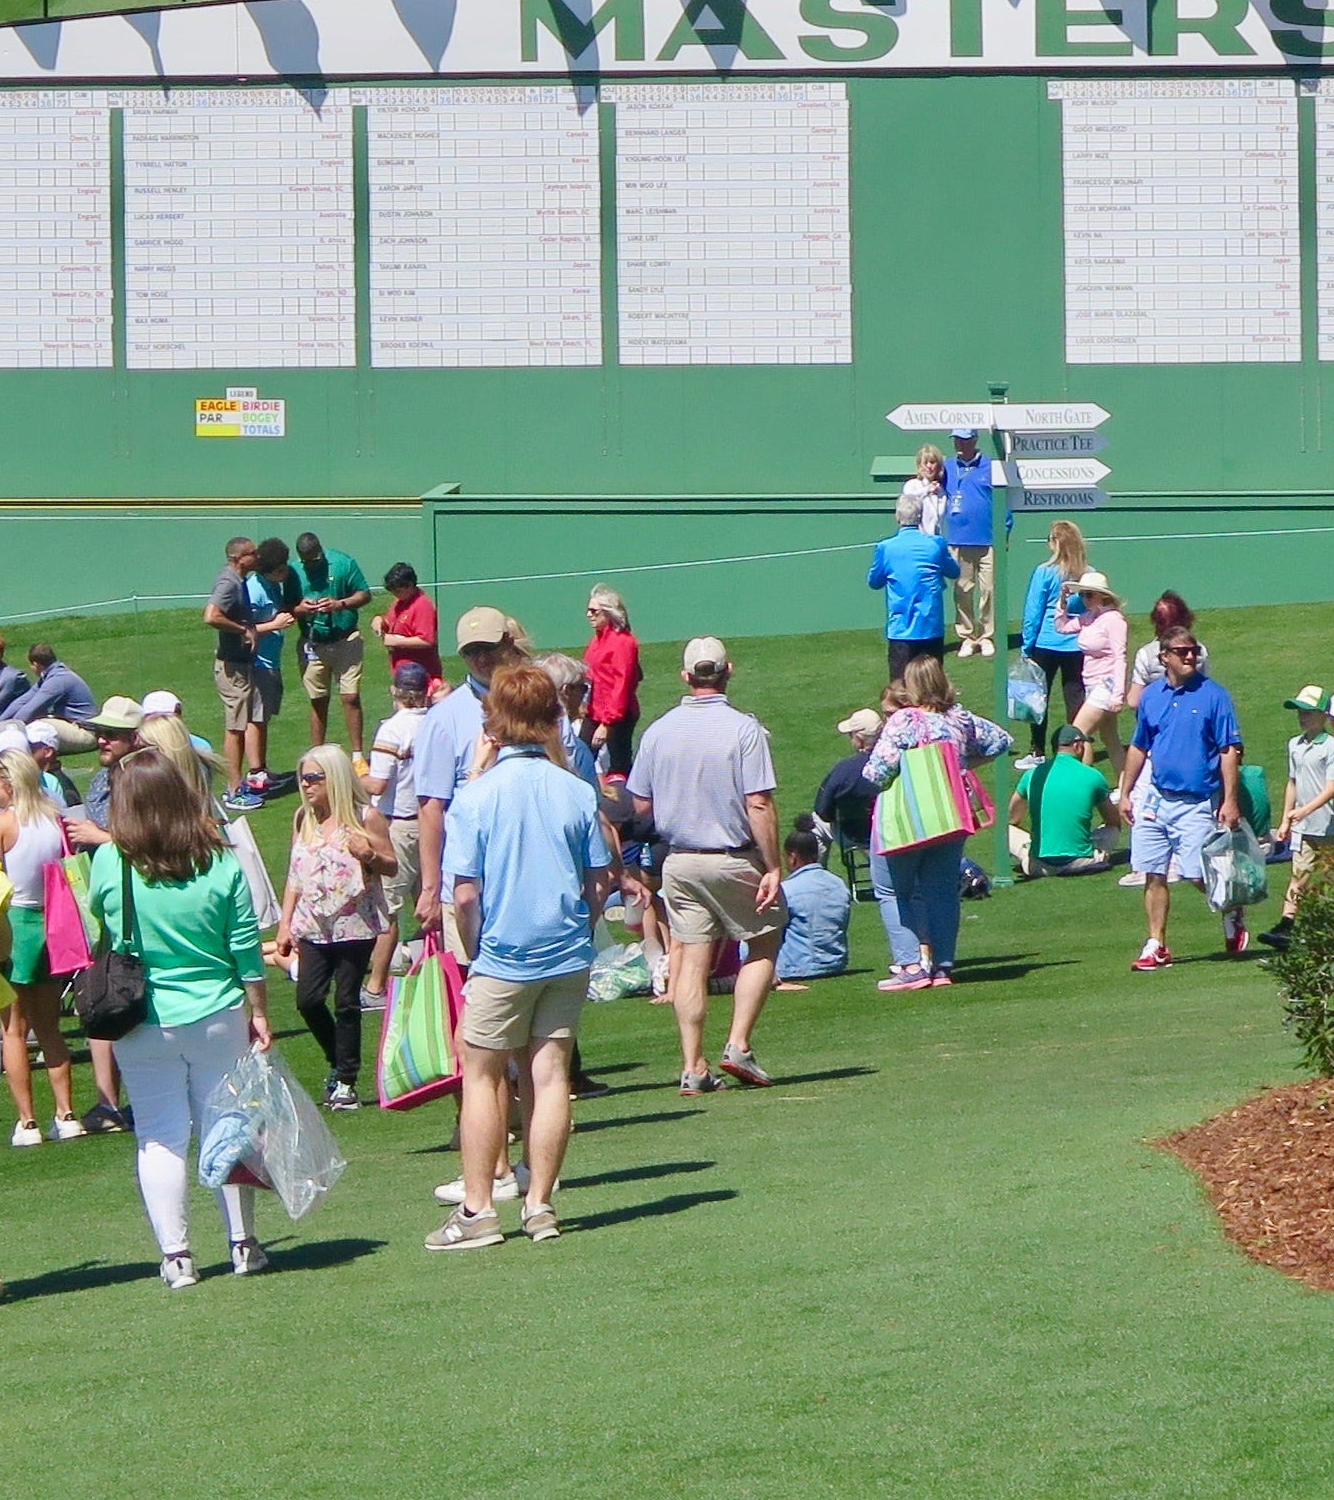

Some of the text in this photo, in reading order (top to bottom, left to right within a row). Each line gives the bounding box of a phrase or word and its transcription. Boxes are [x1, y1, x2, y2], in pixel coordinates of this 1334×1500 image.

[200, 402, 236, 411] EAGLE
[242, 402, 281, 411] BIRDIE
[199, 413, 223, 422] PAR
[243, 413, 279, 423] BOGEY
[904, 410, 985, 425] AMEN CORNER
[1025, 409, 1092, 424] NORTH GATE
[243, 425, 280, 435] TOTALS
[1012, 436, 1093, 452] PRACTICE TEE
[1017, 465, 1095, 480] CONCESSIONS
[1023, 490, 1095, 506] RESTROOMS
